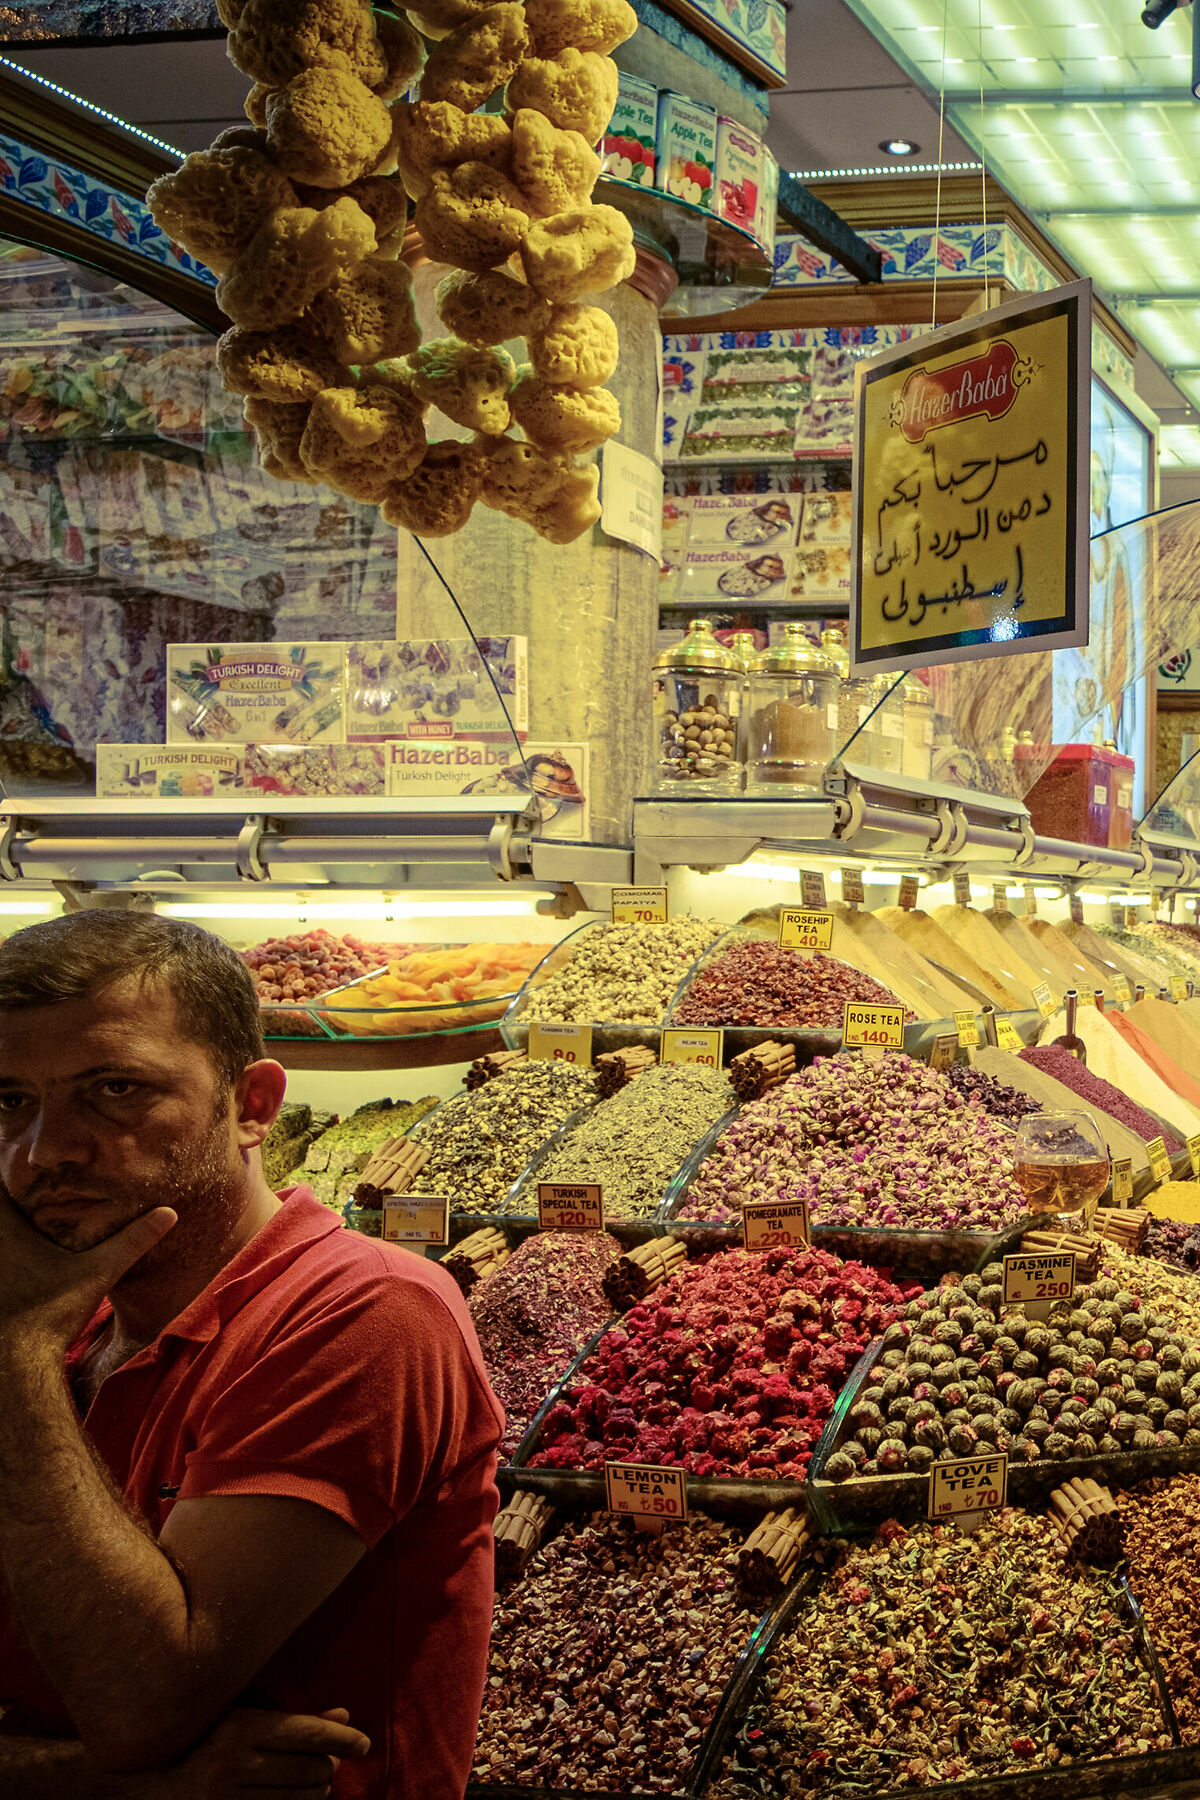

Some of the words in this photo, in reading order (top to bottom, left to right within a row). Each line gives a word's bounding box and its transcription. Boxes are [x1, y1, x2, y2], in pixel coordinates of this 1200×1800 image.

[613, 103, 635, 119] pple
[638, 108, 653, 126] Tea
[671, 121, 697, 141] Apple
[698, 131, 713, 149] Tea
[908, 363, 1009, 427] HazerBaba
[685, 551, 751, 563] HazerBaba
[211, 664, 255, 679] TURKISH
[256, 662, 302, 679] DELIGHT
[143, 754, 188, 766] TURKISH
[190, 754, 234, 767] DELIGHT
[391, 744, 510, 766] HazerBaba
[395, 770, 433, 781] Turkish
[434, 770, 471, 783] Delight
[634, 910, 653, 921] 70
[786, 914, 830, 925] ROSEHIP
[796, 924, 818, 934] TEA
[799, 935, 818, 947] 40
[819, 940, 828, 948] TL
[849, 1012, 878, 1025] ROSE
[879, 1012, 901, 1026] TEA
[860, 1029, 888, 1045] 140
[889, 1034, 900, 1044] TL
[551, 1189, 587, 1199] TURKISH
[543, 1199, 578, 1210] SPECIAL
[581, 1200, 598, 1211] TEA
[556, 1211, 586, 1226] 120
[587, 1218, 599, 1226] TL
[746, 1206, 802, 1221] POMEGRANATE
[767, 1220, 783, 1231] TEA
[430, 1231, 441, 1239] TL
[760, 1231, 791, 1247] 220
[1008, 1256, 1072, 1272] JASMINE
[1024, 1268, 1055, 1282] TEA
[1035, 1282, 1070, 1298] 250
[612, 1468, 677, 1485] LEMON
[940, 1461, 1000, 1480] LOVE
[626, 1481, 665, 1496] TEA
[945, 1474, 993, 1491] TEA
